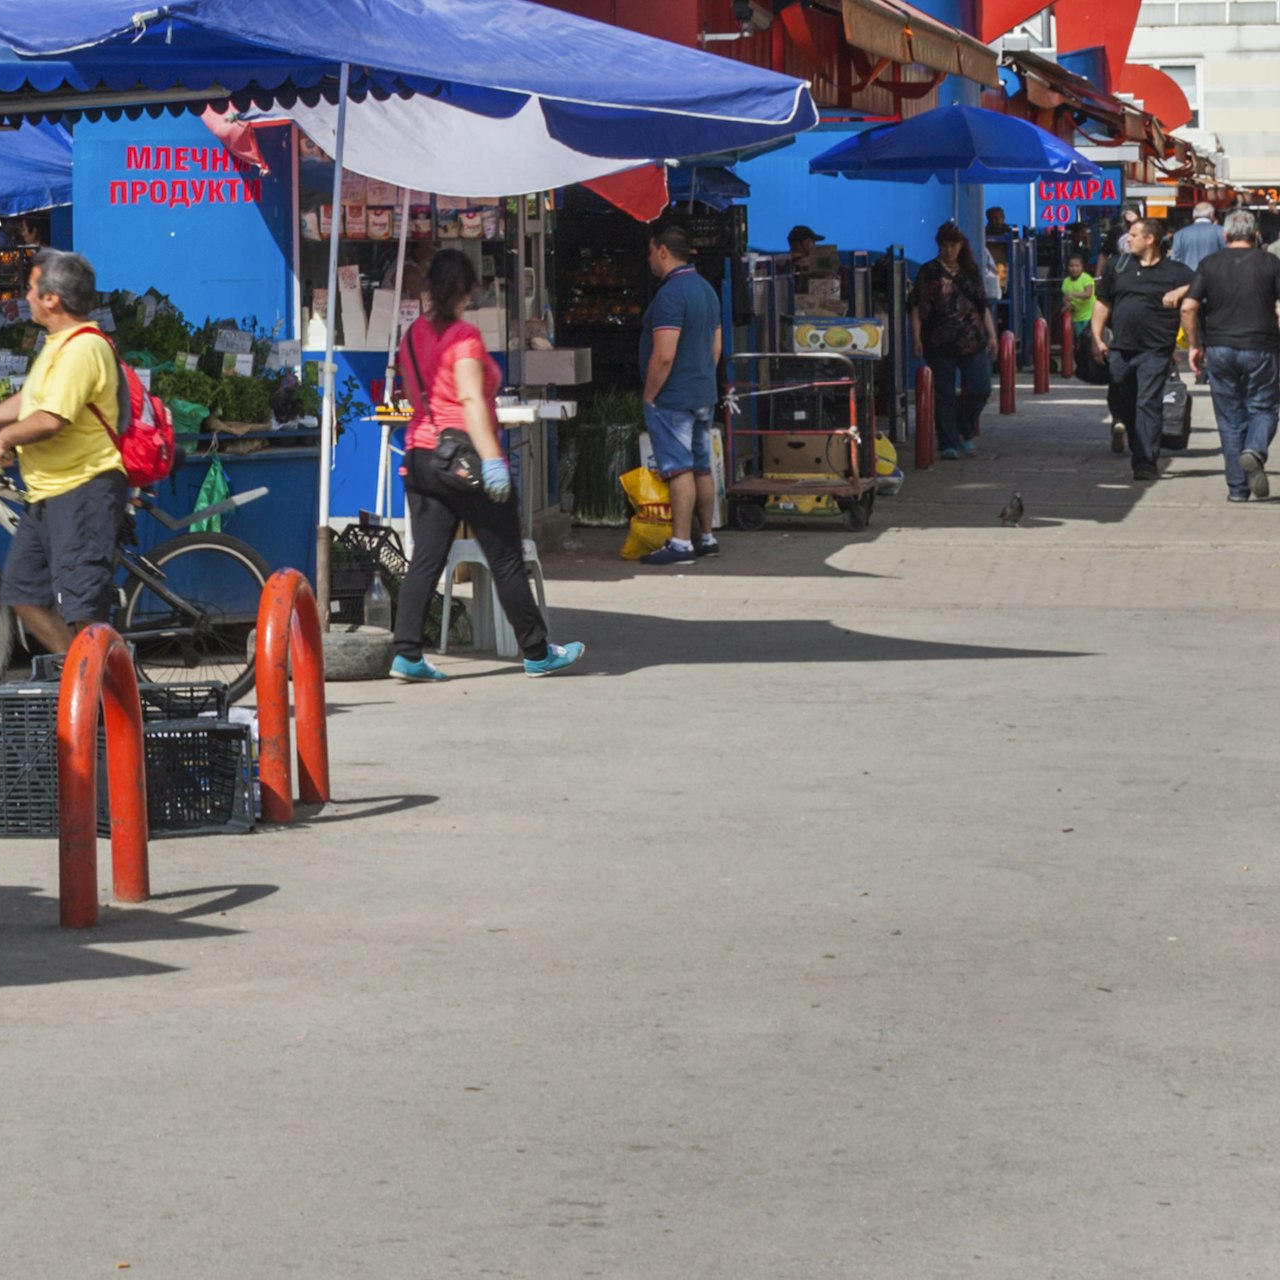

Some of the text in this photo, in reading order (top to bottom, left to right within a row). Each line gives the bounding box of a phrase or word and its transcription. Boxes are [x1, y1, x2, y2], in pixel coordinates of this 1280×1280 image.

[126, 146, 252, 172] МЛЕЧНИ
[109, 179, 262, 208] ПРОДУКТИ
[1038, 179, 1116, 201] СКАРА
[1041, 205, 1071, 223] 40
